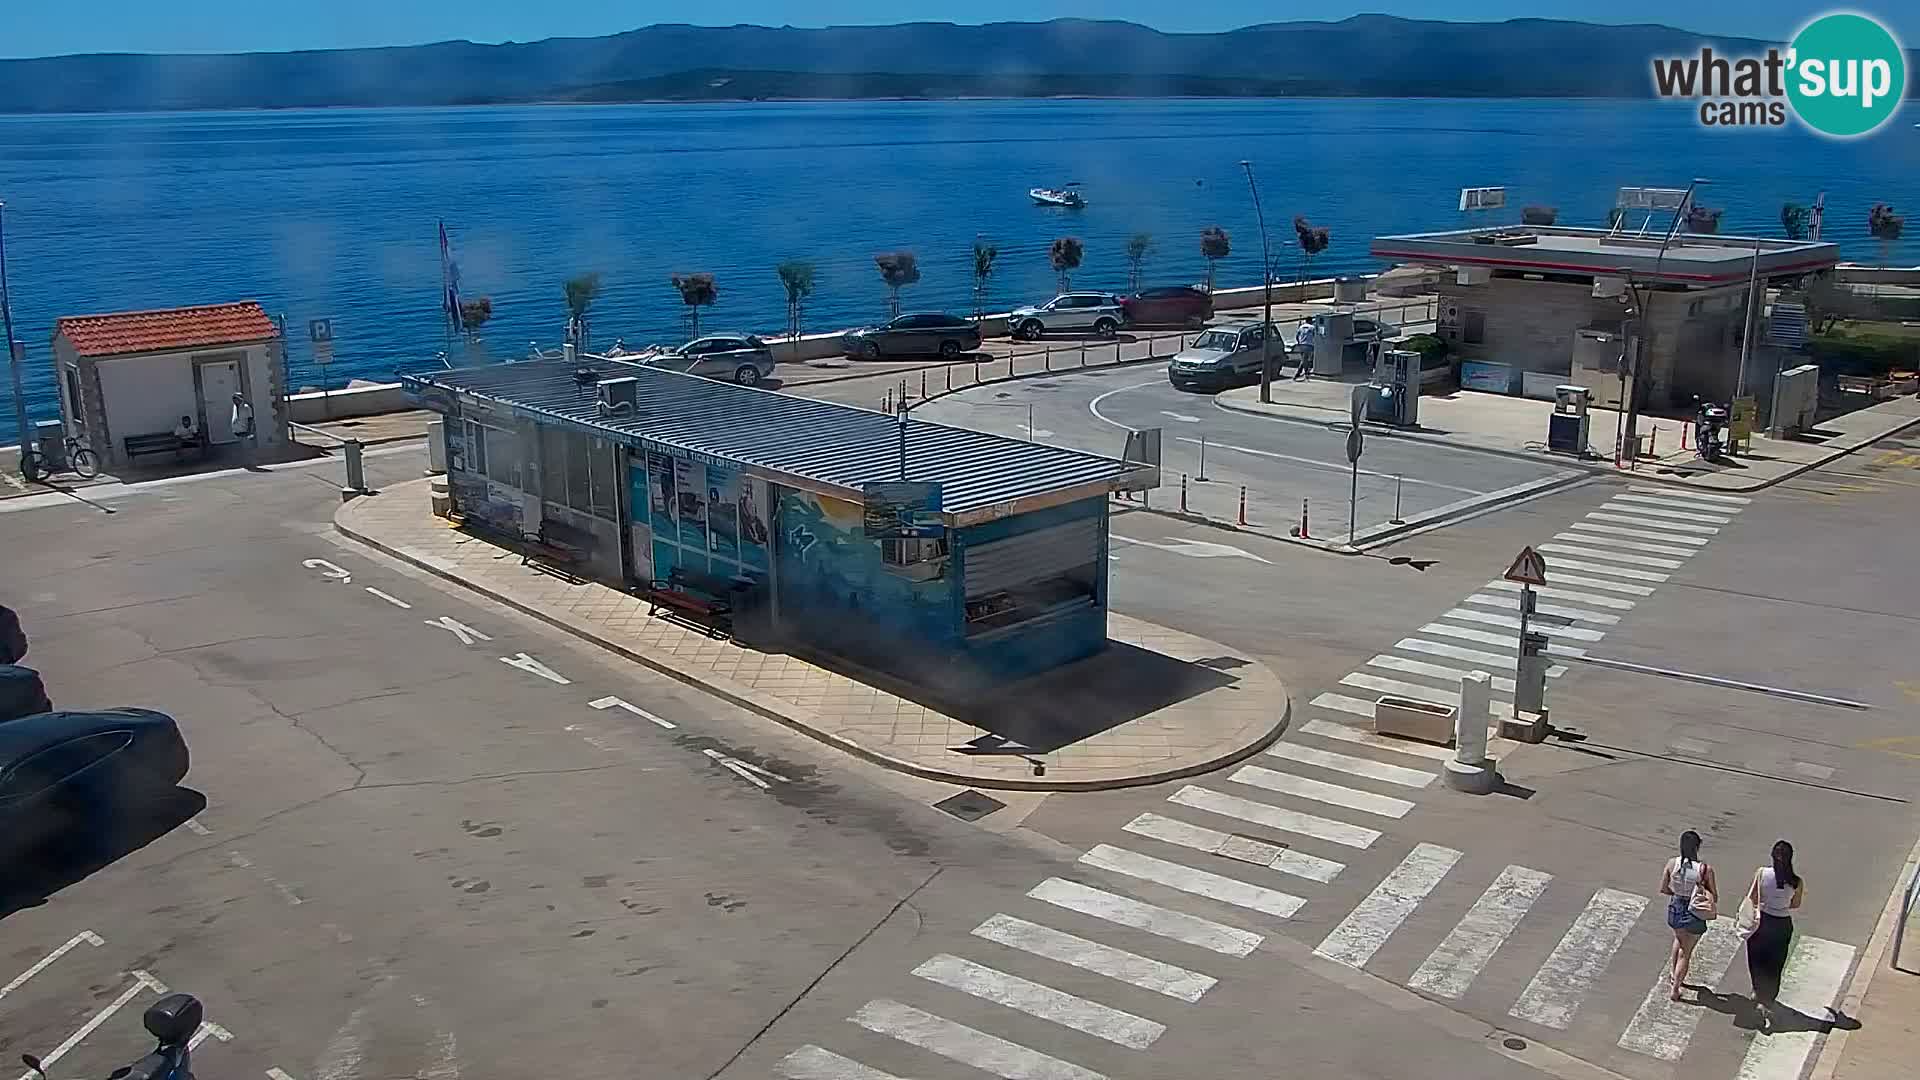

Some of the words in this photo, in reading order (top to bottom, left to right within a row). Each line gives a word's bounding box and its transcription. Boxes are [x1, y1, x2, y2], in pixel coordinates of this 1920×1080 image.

[315, 322, 326, 338] P
[657, 444, 688, 459] STATION
[691, 451, 715, 465] TICKET
